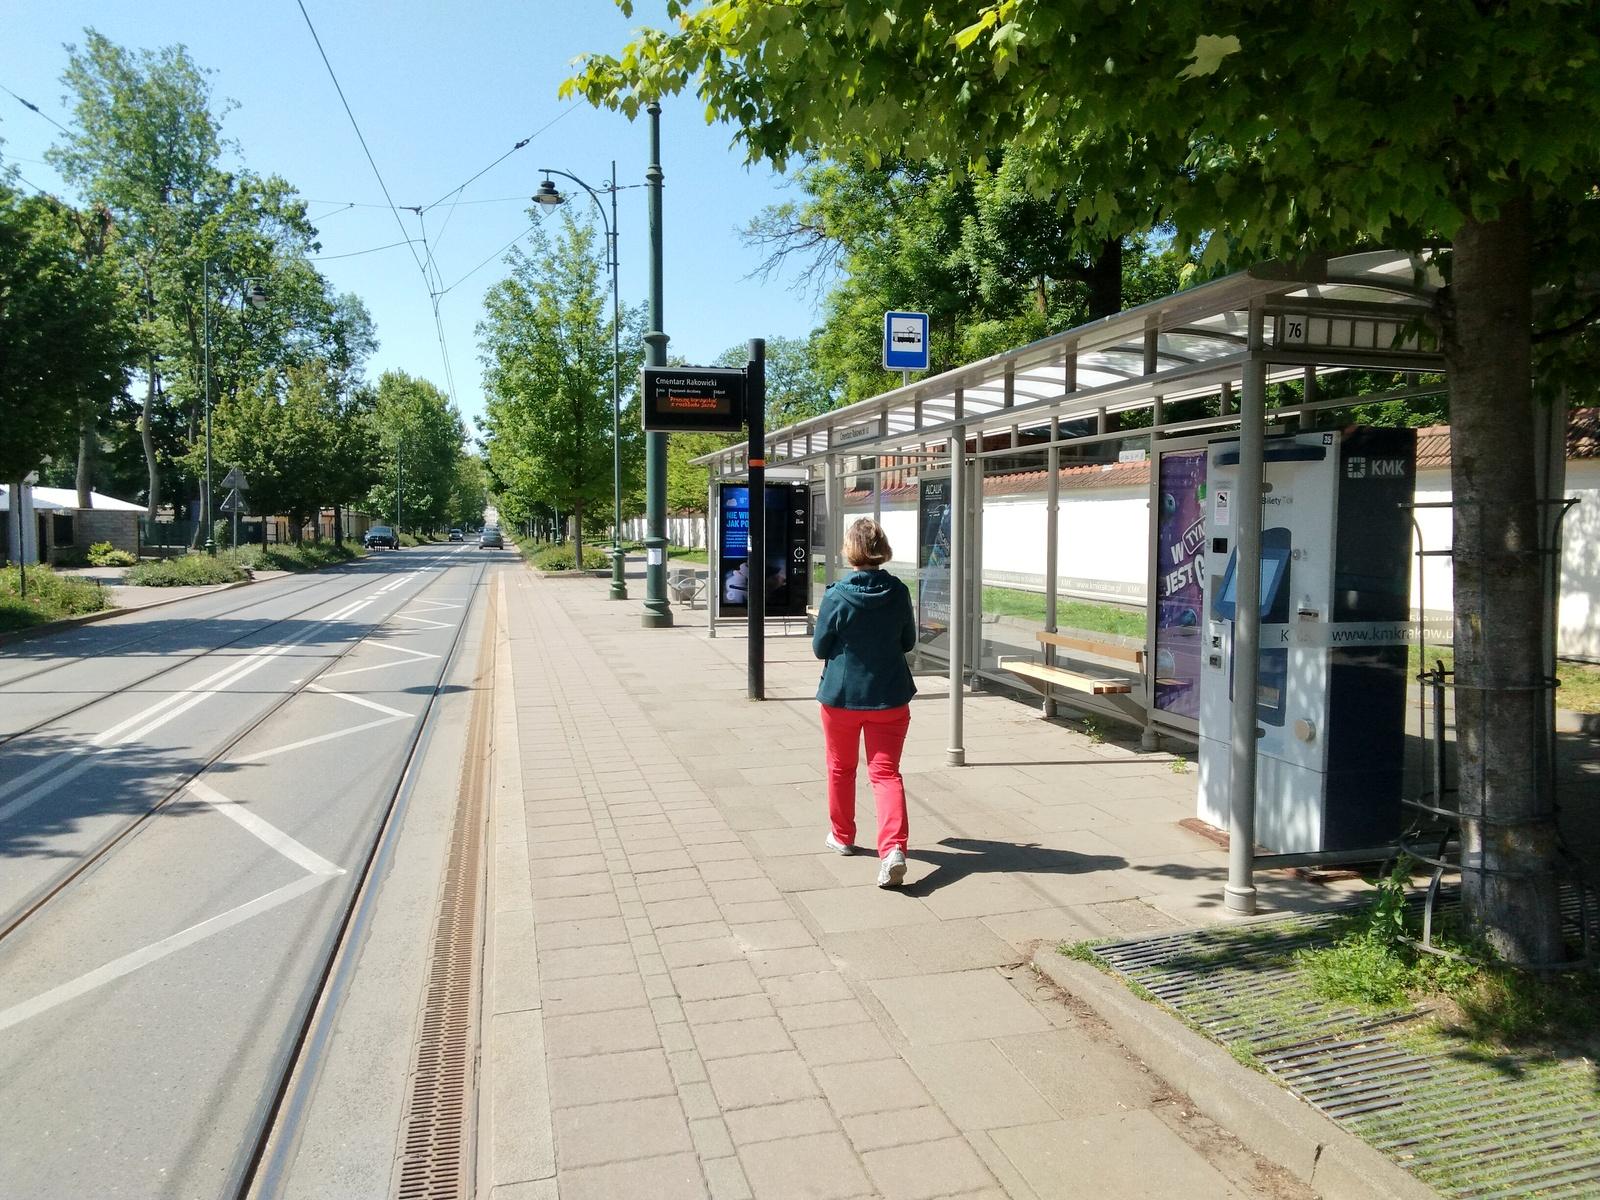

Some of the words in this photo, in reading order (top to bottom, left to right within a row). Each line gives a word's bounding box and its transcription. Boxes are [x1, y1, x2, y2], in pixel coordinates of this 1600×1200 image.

[1288, 323, 1302, 338] 76
[656, 377, 685, 385] Cmentarz
[686, 378, 717, 387] Rakowicki
[1371, 459, 1406, 476] KMK
[1171, 541, 1184, 565] W
[1166, 562, 1193, 597] JEST
[1332, 626, 1454, 644] www.kmkrakow.p
